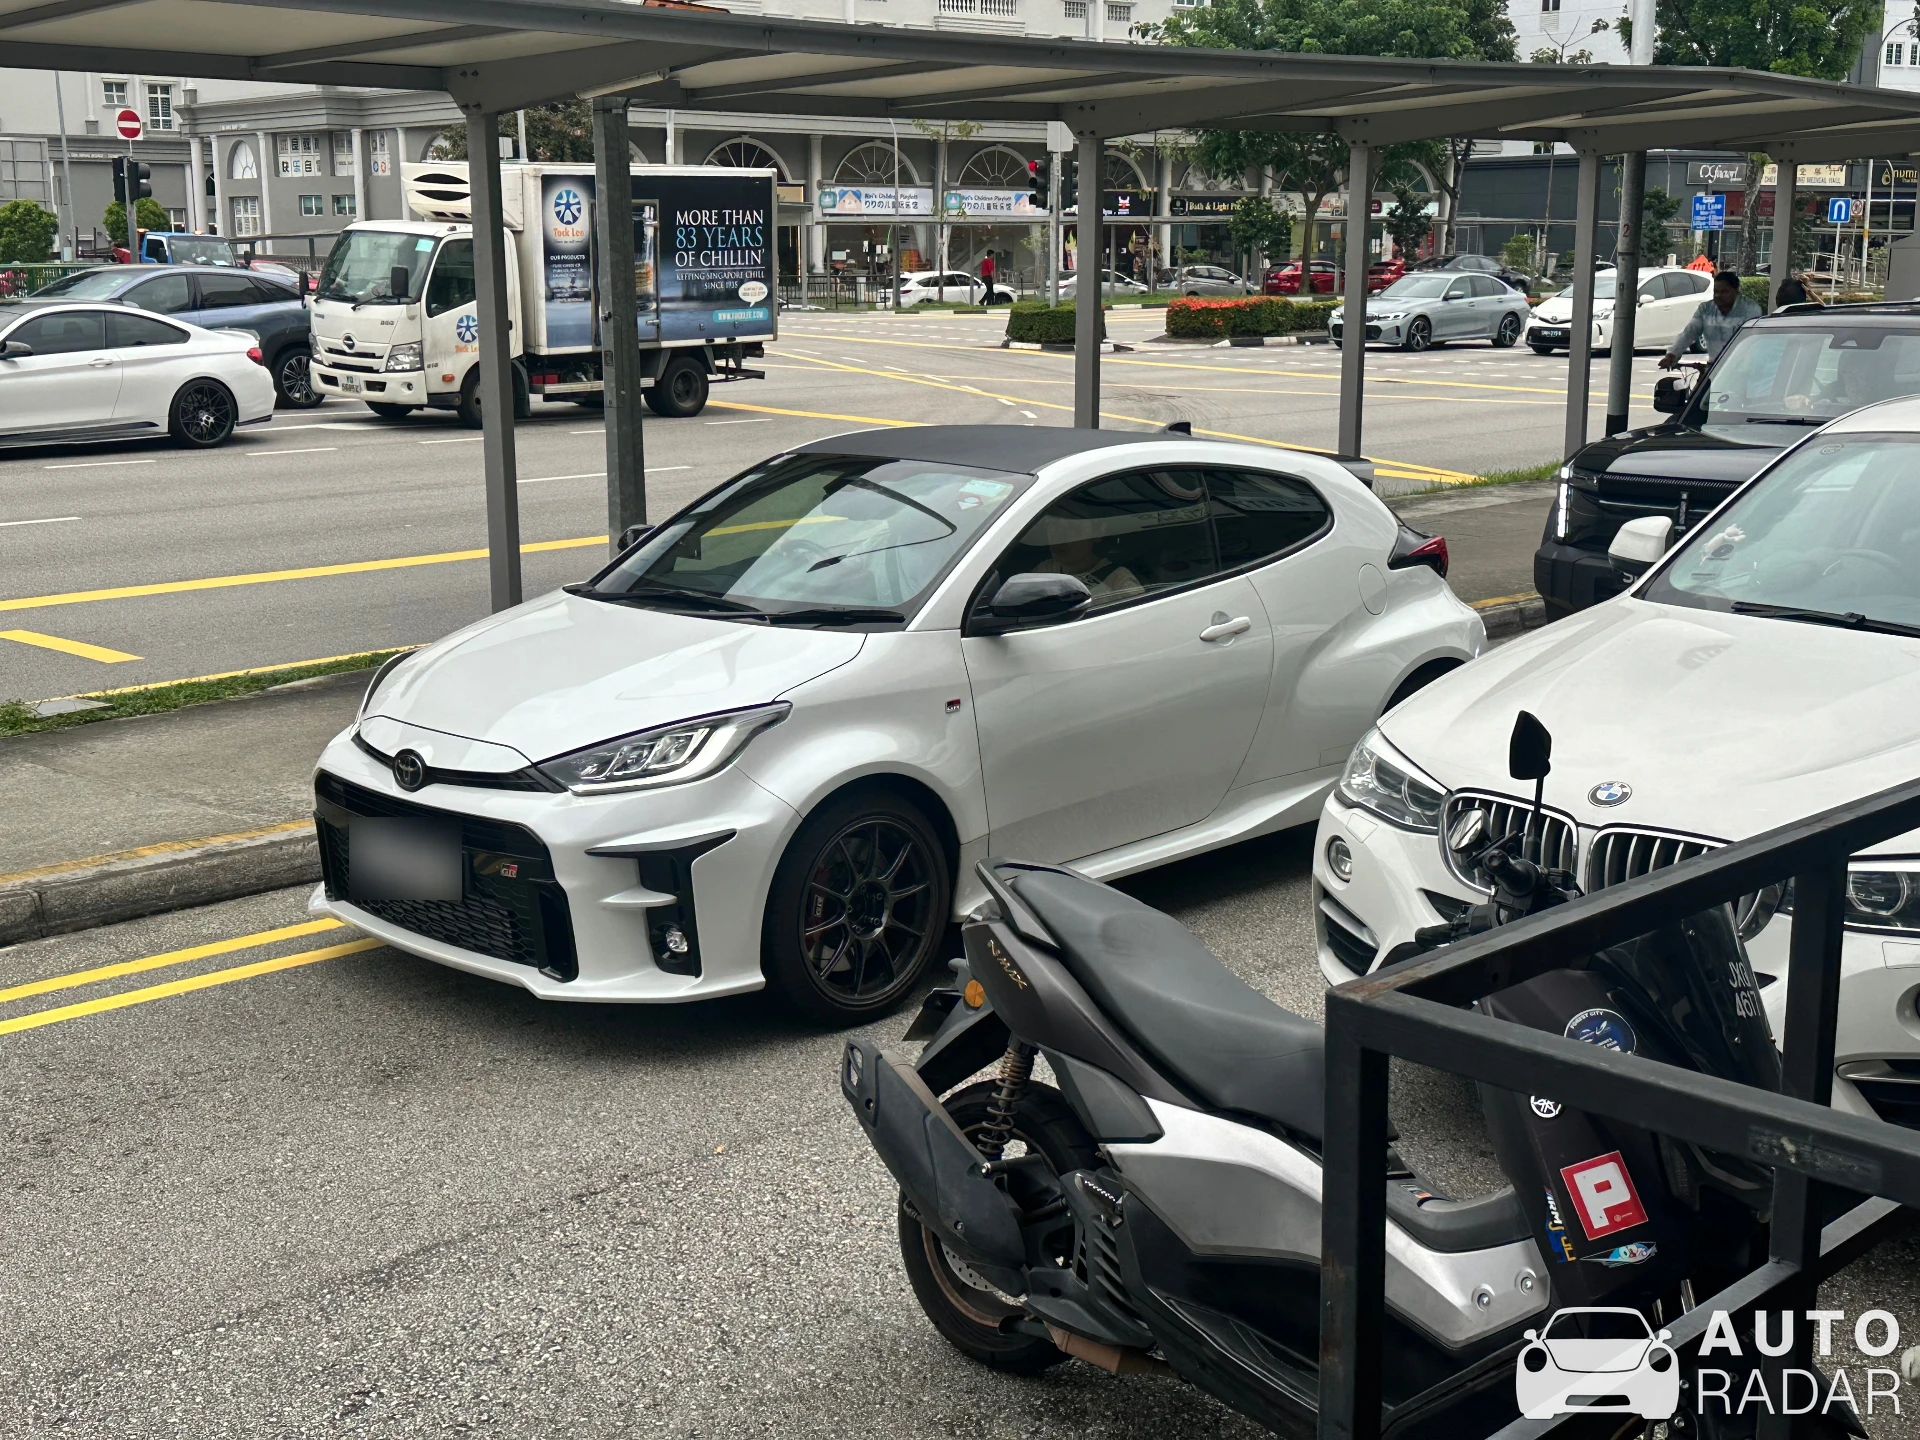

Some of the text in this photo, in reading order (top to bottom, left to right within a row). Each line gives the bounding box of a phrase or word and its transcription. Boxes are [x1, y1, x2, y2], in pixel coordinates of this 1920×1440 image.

[1189, 201, 1204, 211] Bath
[1205, 202, 1212, 210] &
[1213, 201, 1229, 212] Light
[676, 209, 764, 226] MORE THAN
[676, 226, 763, 249] 83 YEARS
[1622, 223, 1630, 238] 2
[675, 248, 765, 267] OF CHILLIN'
[676, 270, 765, 281] KEEPING SINGAPORE CHILL
[704, 281, 724, 289] SINCE
[1735, 990, 1761, 1019] 4617
[1570, 1012, 1589, 1030] FOREST
[1573, 1161, 1632, 1230] P
